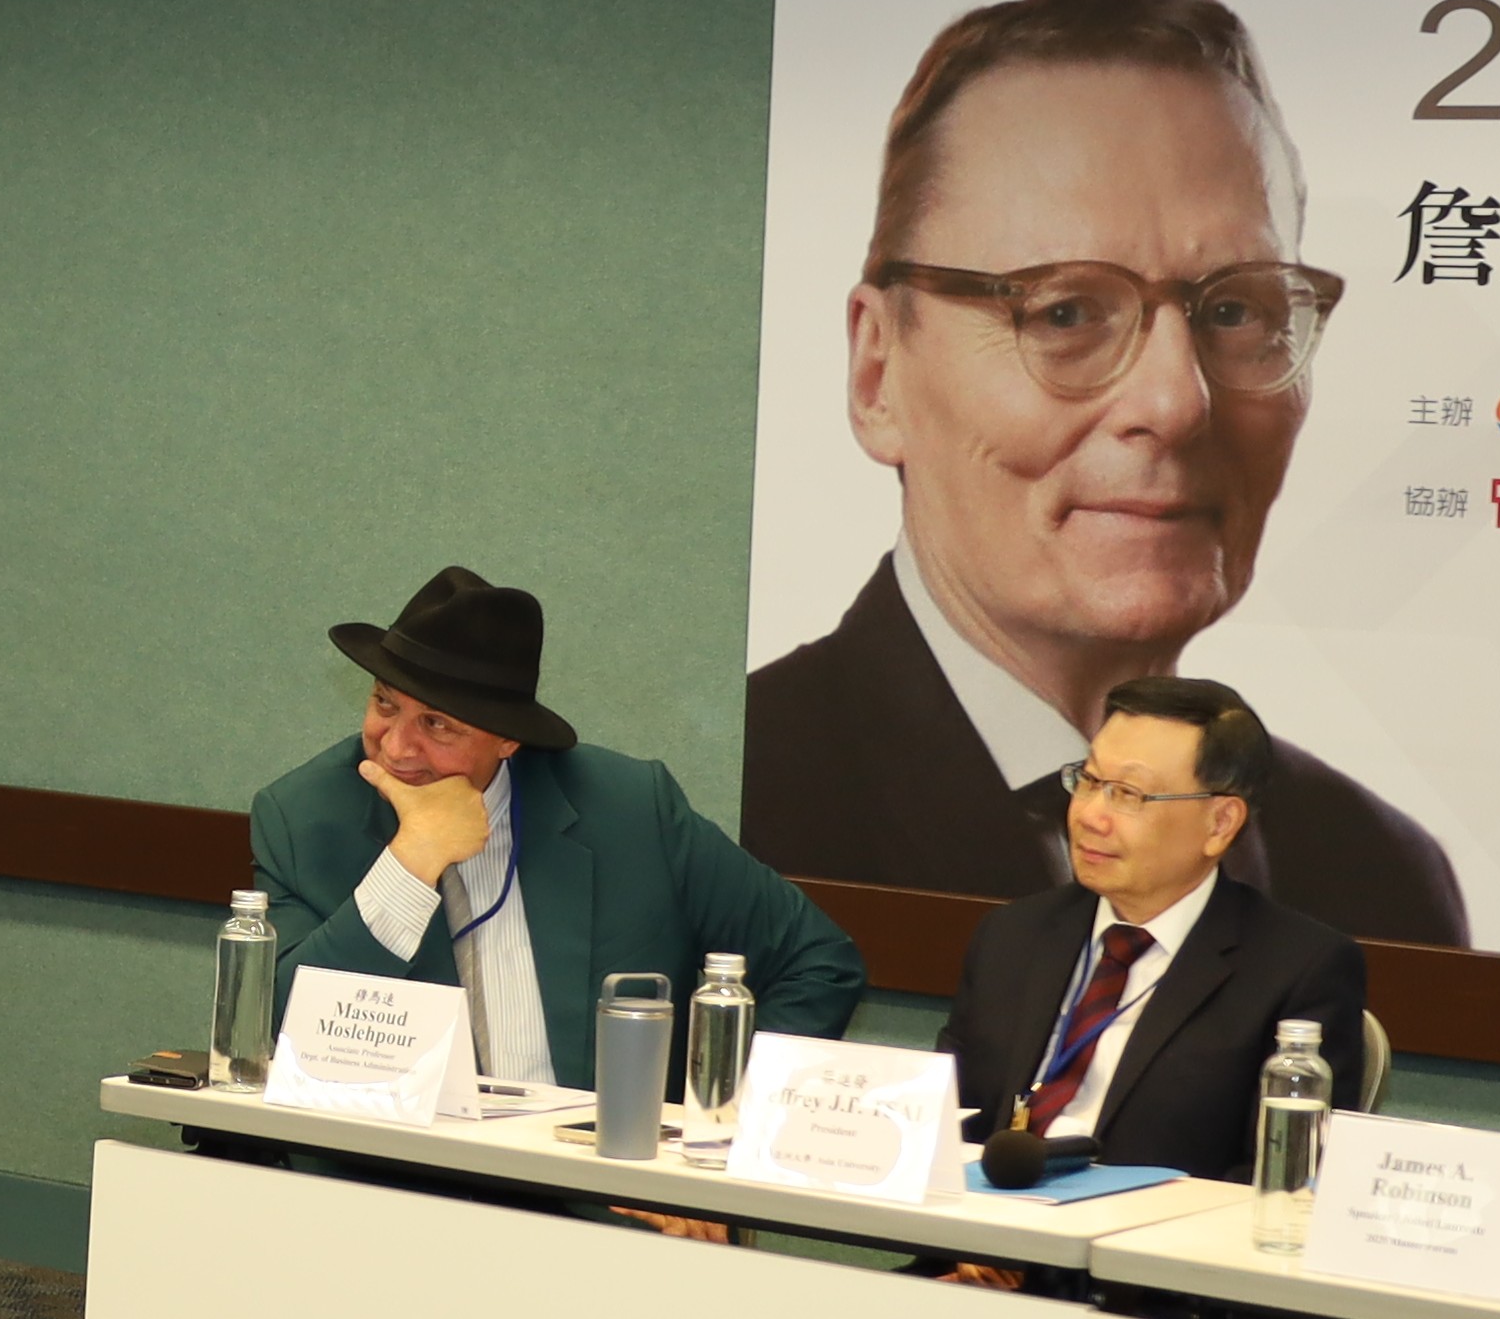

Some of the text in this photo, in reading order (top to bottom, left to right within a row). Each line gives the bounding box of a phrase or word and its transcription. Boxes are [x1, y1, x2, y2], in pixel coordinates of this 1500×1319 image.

[1407, 395, 1474, 428] 主辦
[1403, 486, 1470, 519] 協辦
[333, 1000, 409, 1028] Massoud
[316, 1018, 417, 1048] Moslehpour
[767, 1086, 821, 1114] effrey
[1377, 1151, 1475, 1183] James A.
[1369, 1177, 1473, 1210] Robinson
